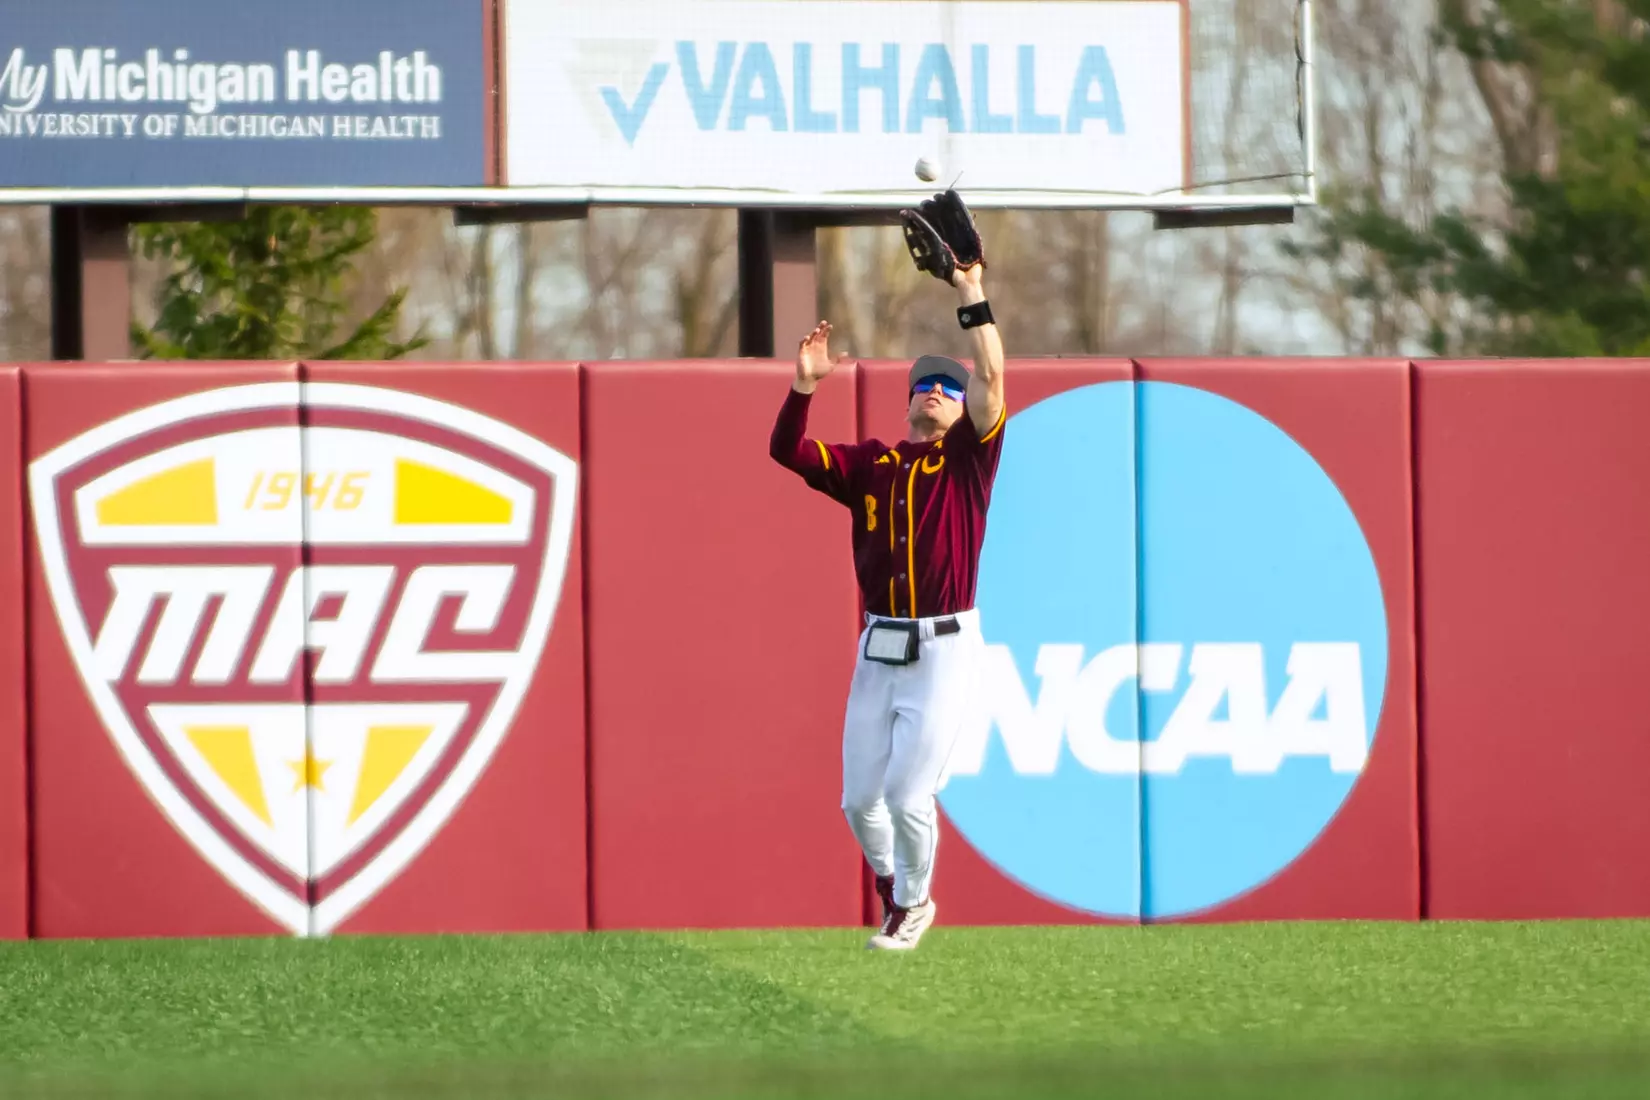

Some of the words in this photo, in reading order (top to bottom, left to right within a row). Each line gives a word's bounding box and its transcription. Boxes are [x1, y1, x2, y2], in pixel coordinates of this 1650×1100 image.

[54, 48, 274, 114] Michigan
[286, 50, 441, 102] Health
[675, 40, 1126, 135] VALHALLA
[0, 113, 137, 137] NIVERSITY
[143, 114, 178, 137] OF
[184, 114, 324, 138] MICHIGAN
[332, 115, 441, 138] HEALTH
[244, 471, 371, 511] 1946
[92, 564, 518, 686] MAC
[938, 641, 1368, 776] NCAA
